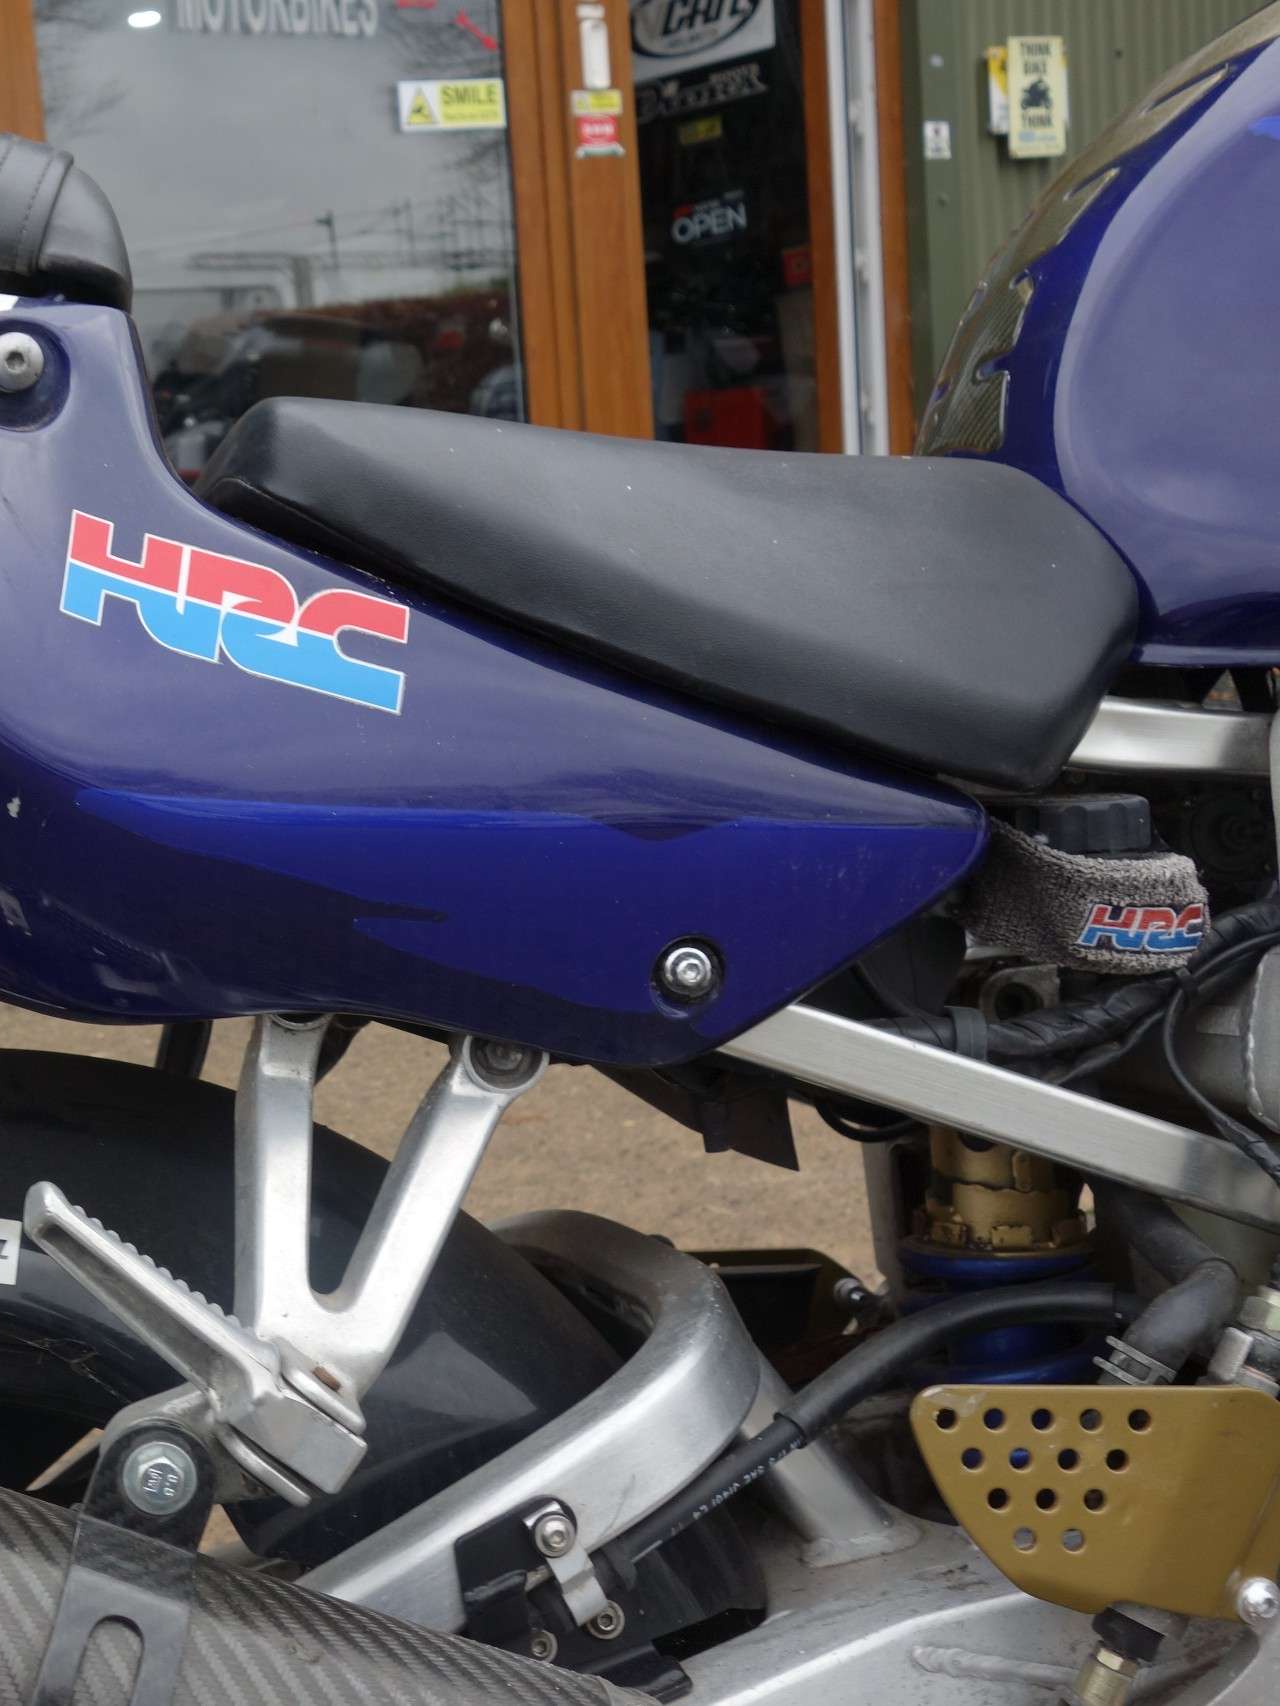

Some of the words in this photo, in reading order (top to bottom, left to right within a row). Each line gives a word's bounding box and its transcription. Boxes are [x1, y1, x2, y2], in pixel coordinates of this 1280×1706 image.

[177, 0, 379, 37] MOTORBIKES
[441, 83, 498, 104] SMILE
[671, 202, 747, 242] OPEN
[60, 509, 410, 715] HRC
[1076, 903, 1204, 952] HRC
